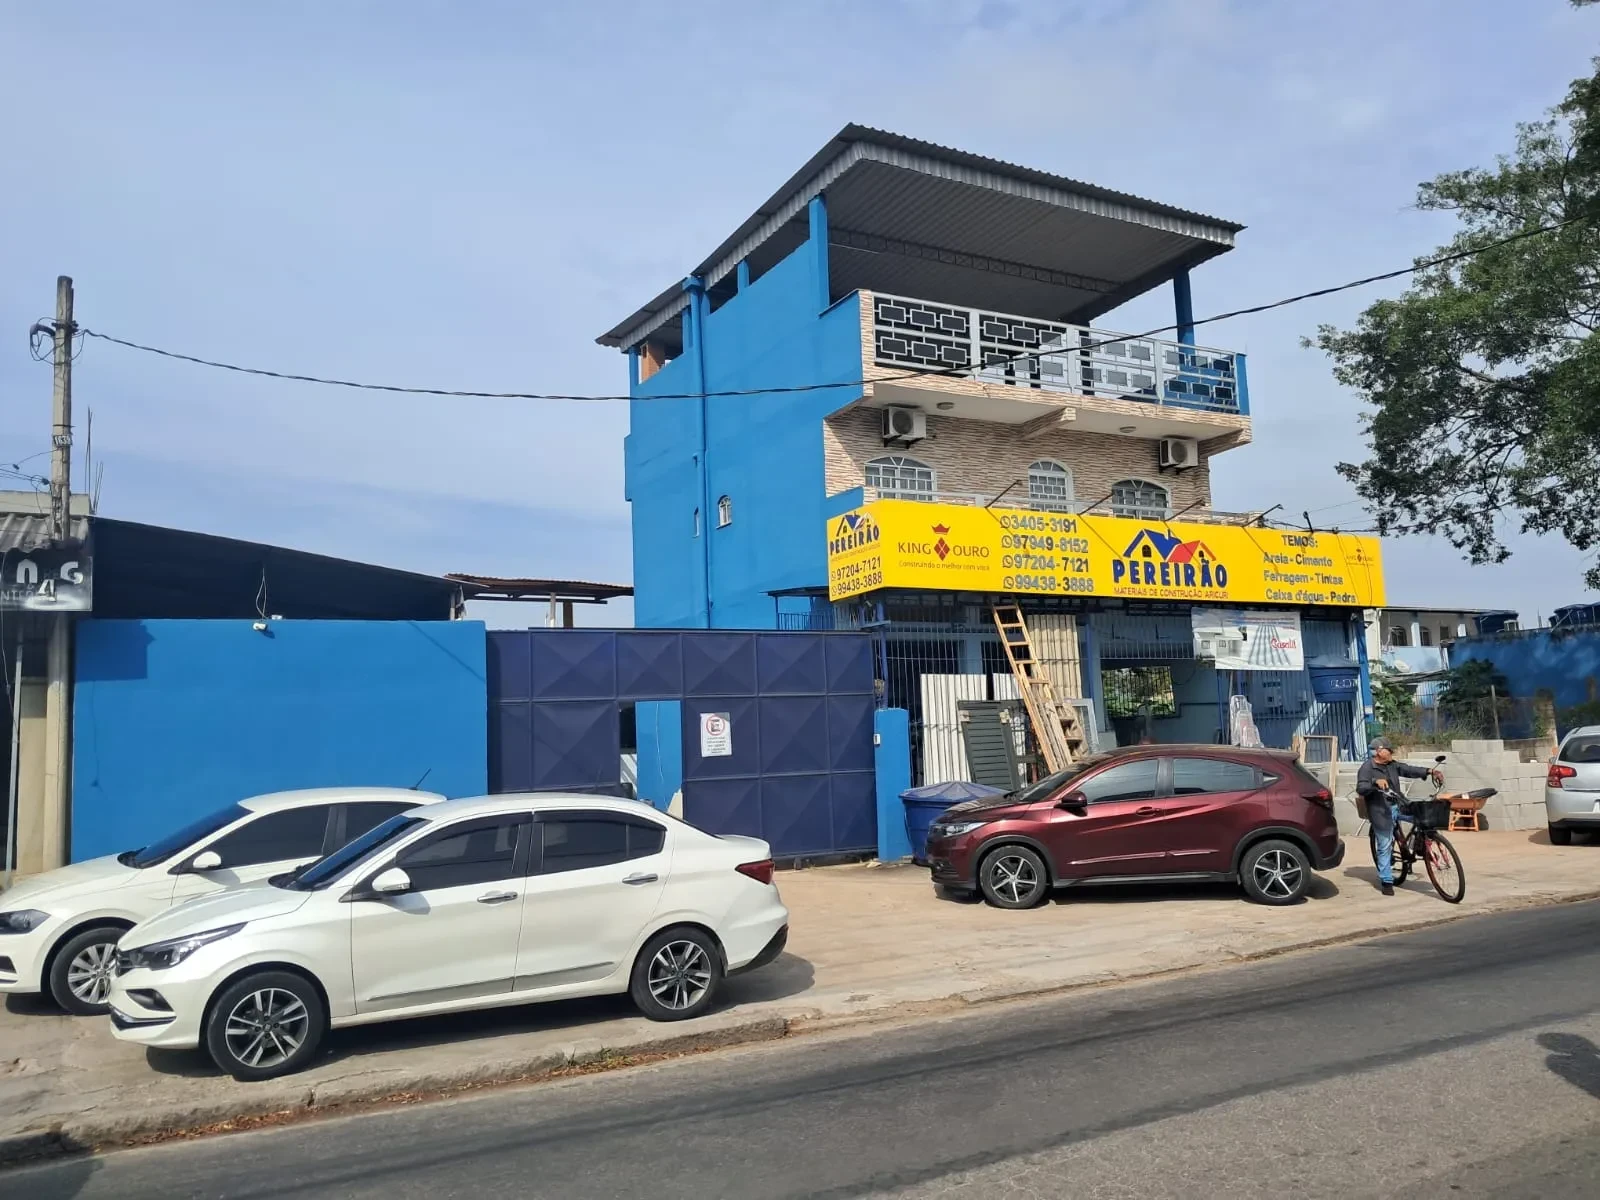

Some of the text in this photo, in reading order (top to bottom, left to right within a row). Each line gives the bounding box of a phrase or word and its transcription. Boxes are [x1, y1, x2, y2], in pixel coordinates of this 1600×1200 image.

[1011, 515, 1077, 533] 3405-3191
[830, 525, 880, 556] PEREIRÃO
[1281, 535, 1318, 548] TEMOS:
[898, 542, 990, 558] KING OURO
[836, 556, 881, 580] 97204-7121
[1013, 554, 1089, 573] 97204-7121
[1263, 552, 1289, 564] Areia
[1295, 554, 1333, 567] Cimento
[1112, 559, 1227, 588] PEREIRÃO
[1263, 570, 1309, 585] Ferragem
[1314, 573, 1344, 585] Tintas
[837, 571, 883, 595] 99438-3888
[1015, 574, 1094, 592] 99438-3888
[1114, 587, 1147, 596] MATERIAIS
[1149, 589, 1158, 597] DE
[1160, 588, 1202, 598] CONSTRUÇÃO
[1265, 588, 1293, 600] Caixa
[1330, 591, 1356, 603] Pedra
